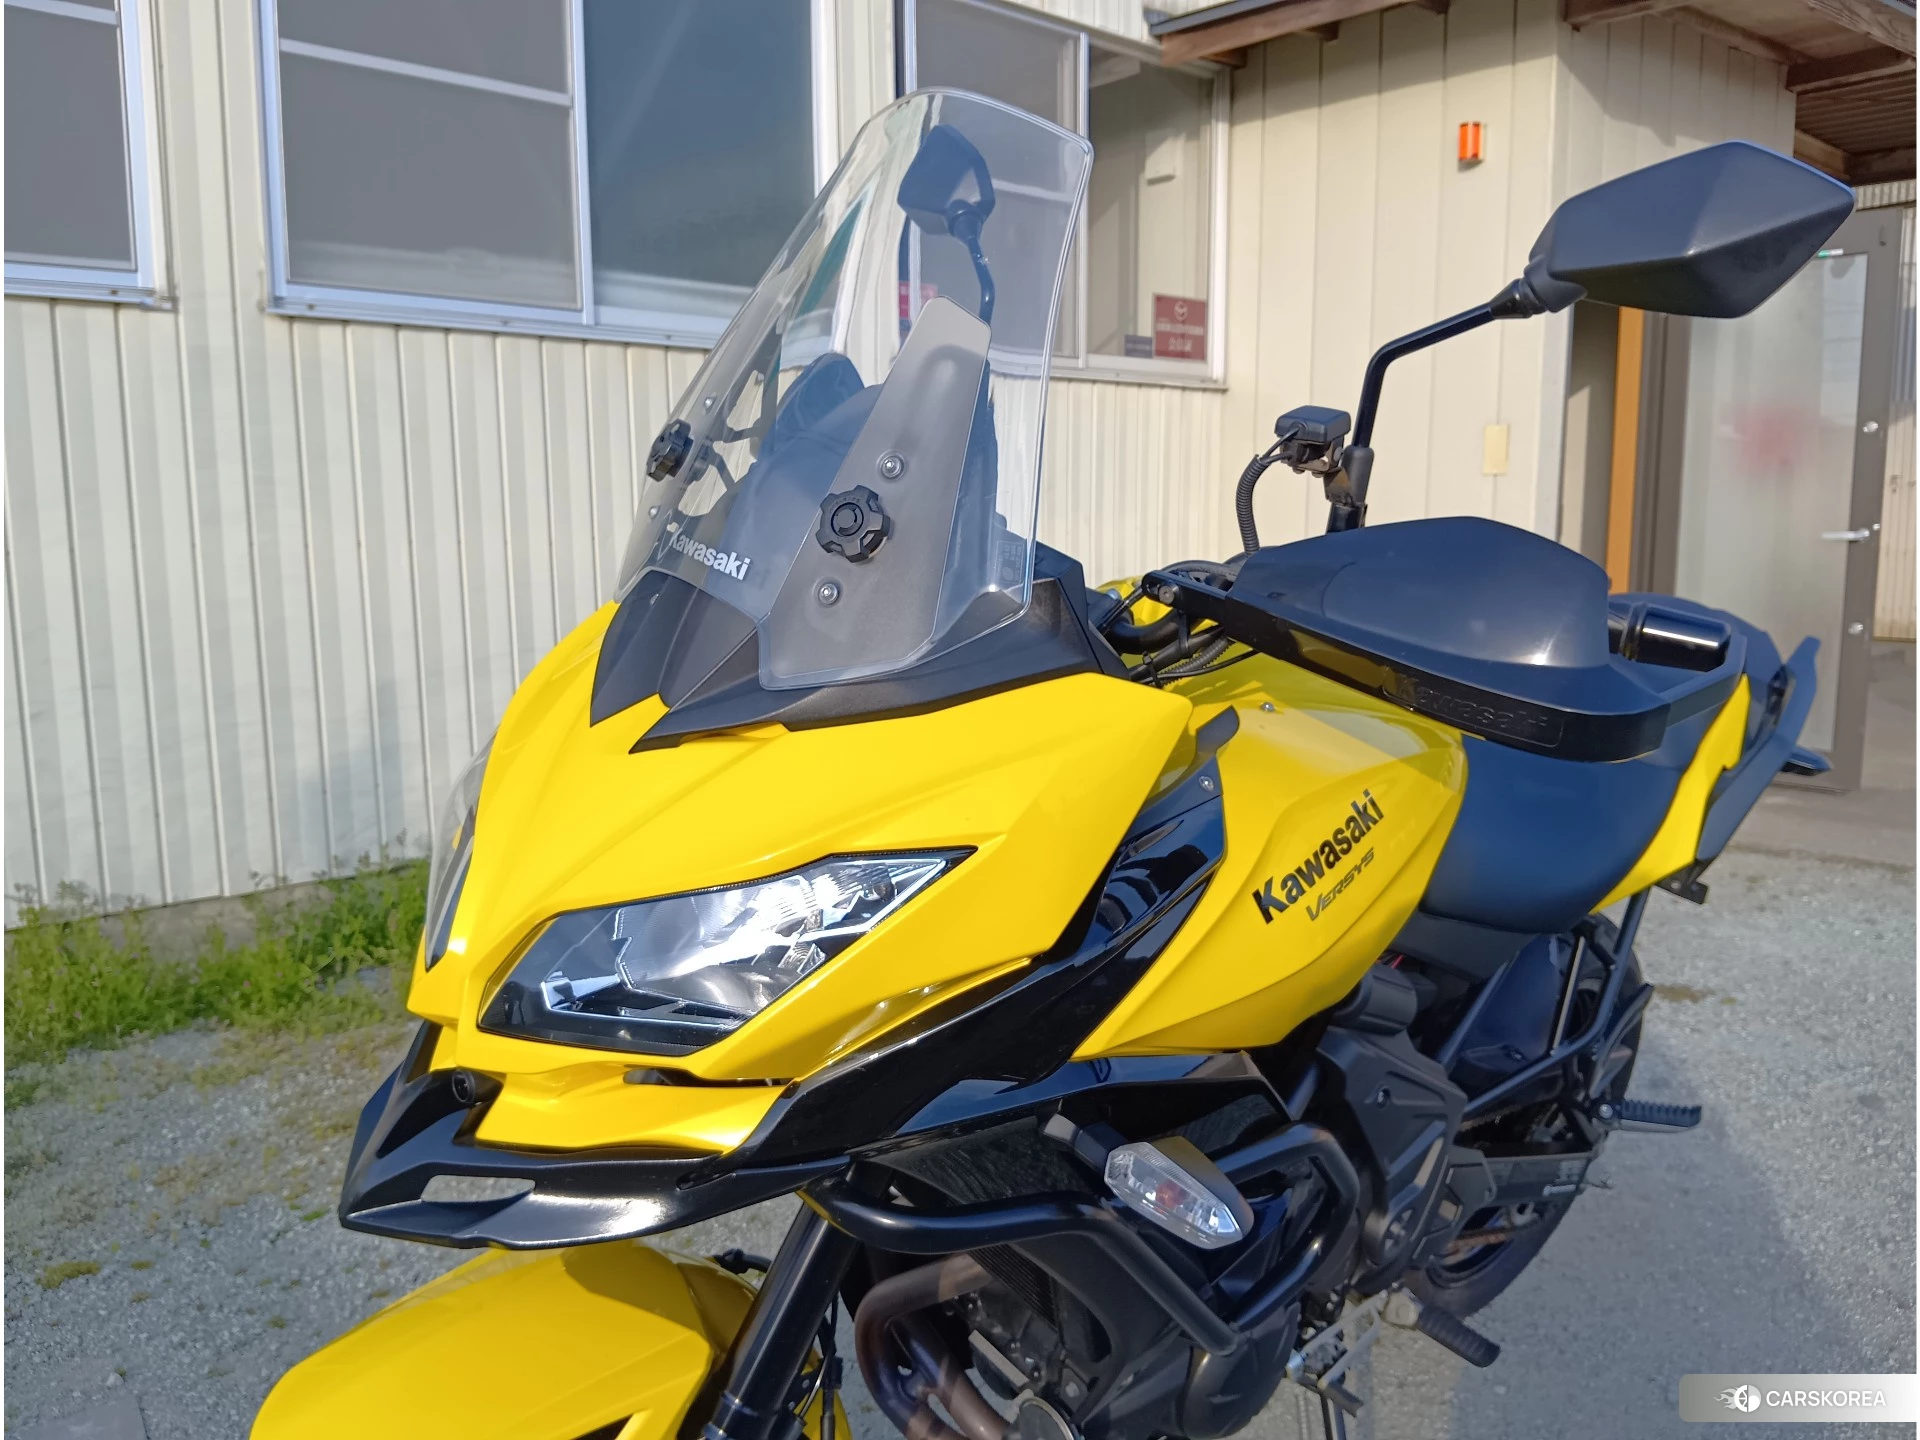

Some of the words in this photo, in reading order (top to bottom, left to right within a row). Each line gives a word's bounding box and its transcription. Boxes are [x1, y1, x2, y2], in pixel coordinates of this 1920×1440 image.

[669, 526, 751, 581] Kawasaki
[1252, 788, 1384, 925] Kawasaki
[1305, 847, 1375, 922] VERSYS
